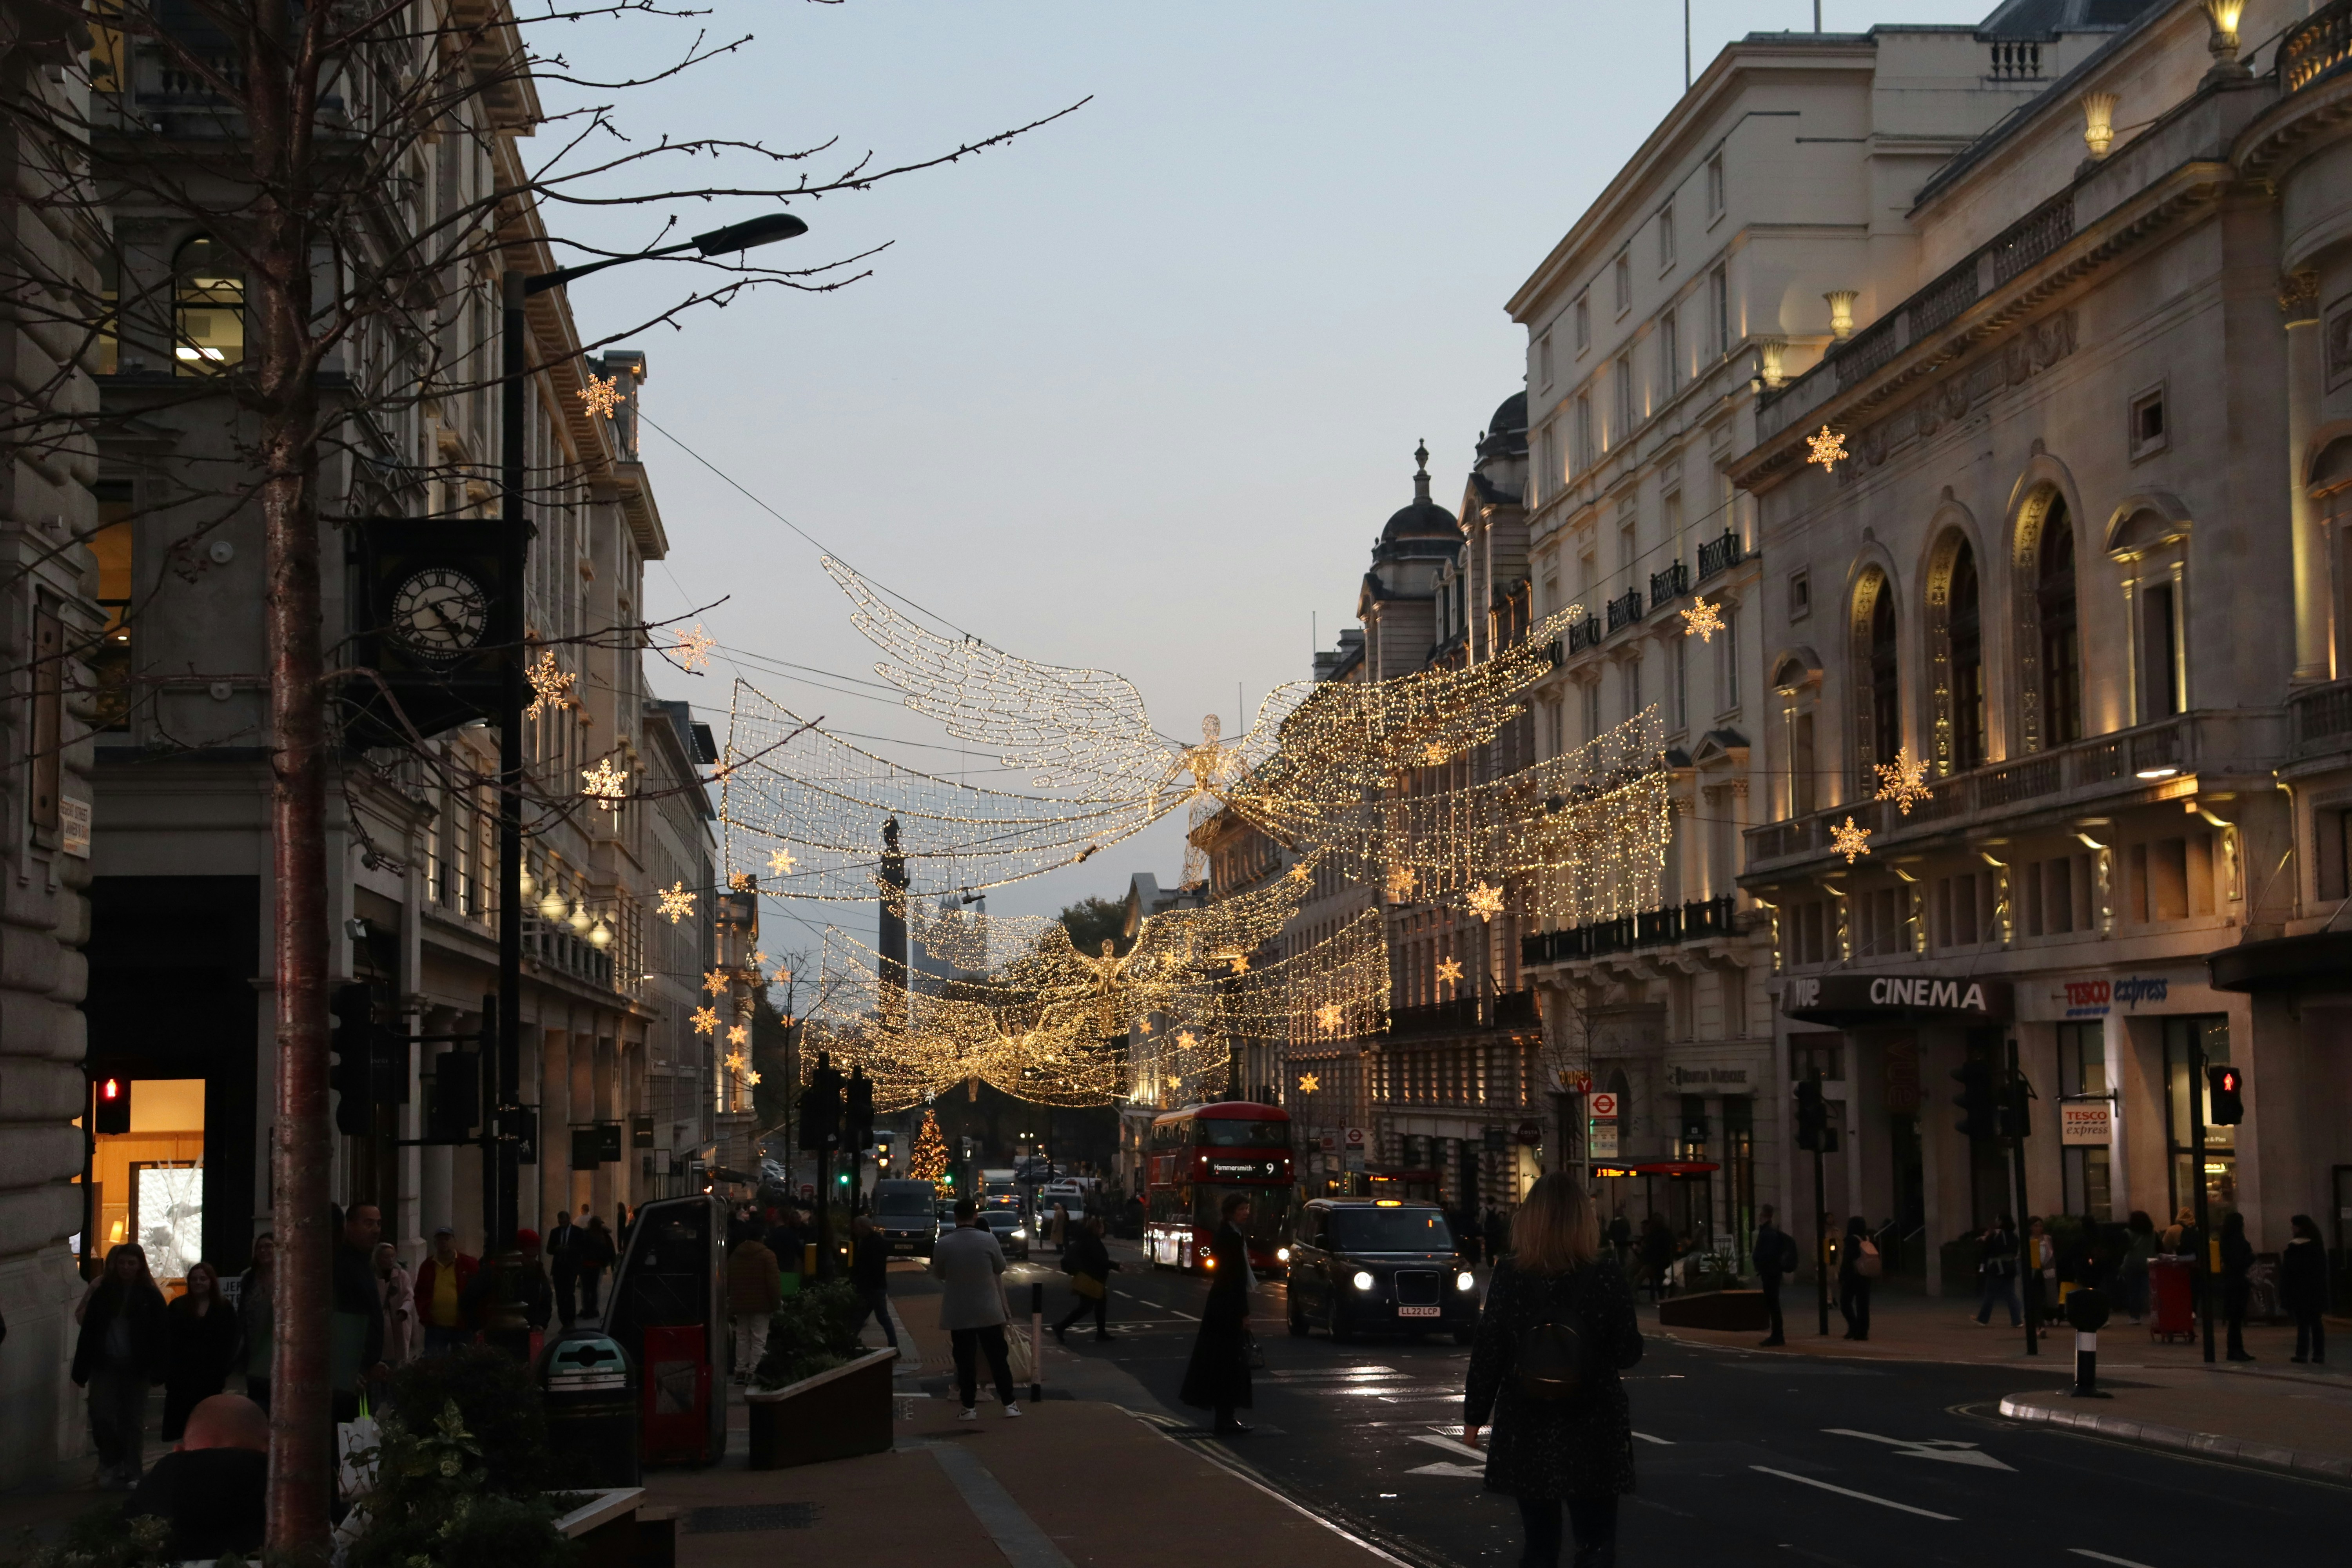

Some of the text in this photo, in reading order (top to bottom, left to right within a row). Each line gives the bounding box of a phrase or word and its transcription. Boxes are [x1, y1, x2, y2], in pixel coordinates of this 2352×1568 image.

[1869, 978, 1986, 1011] CINEMA
[2064, 975, 2167, 1010] TESCO express
[1580, 1080, 1588, 1091] Y
[2066, 1111, 2107, 1120] TESCO
[2066, 1125, 2108, 1136] express
[1214, 1162, 1274, 1174] Hammersmith 9
